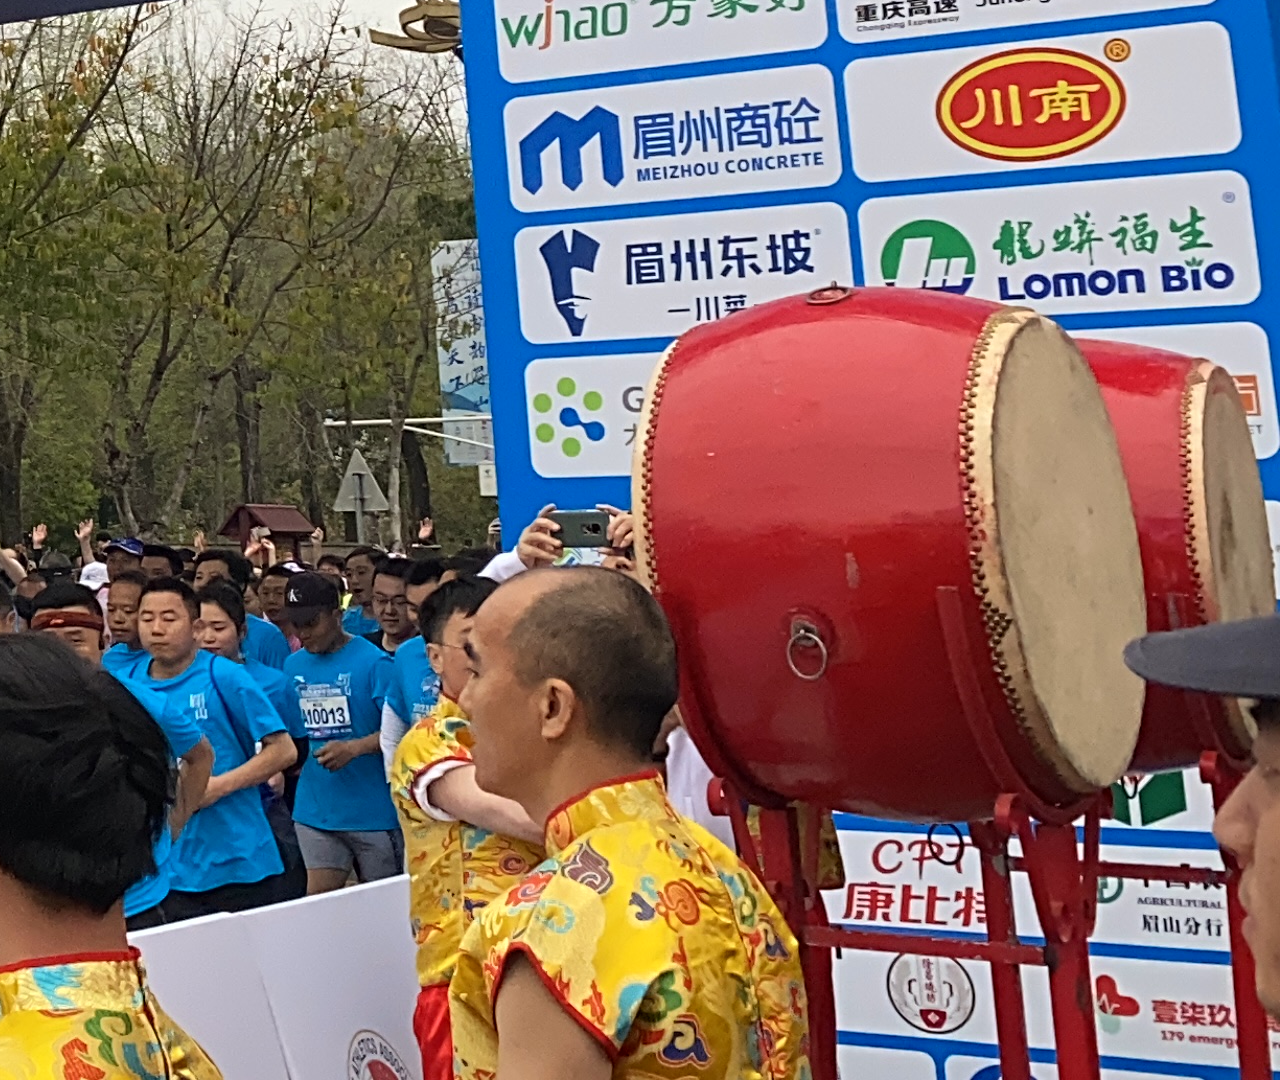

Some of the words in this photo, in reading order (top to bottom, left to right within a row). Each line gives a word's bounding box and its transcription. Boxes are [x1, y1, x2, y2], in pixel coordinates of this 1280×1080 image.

[966, 84, 1101, 129] 川南
[633, 96, 824, 161] 眉州商砼
[636, 160, 720, 183] MEIZHOU
[725, 150, 825, 175] CONCRETE
[626, 229, 816, 286] 眉州东坡
[872, 838, 973, 880] CPT
[842, 883, 987, 928] 康比特
[1137, 897, 1225, 910] AGRICULTURAL
[1142, 913, 1223, 938] 眉山分行
[1161, 1029, 1185, 1042] 179
